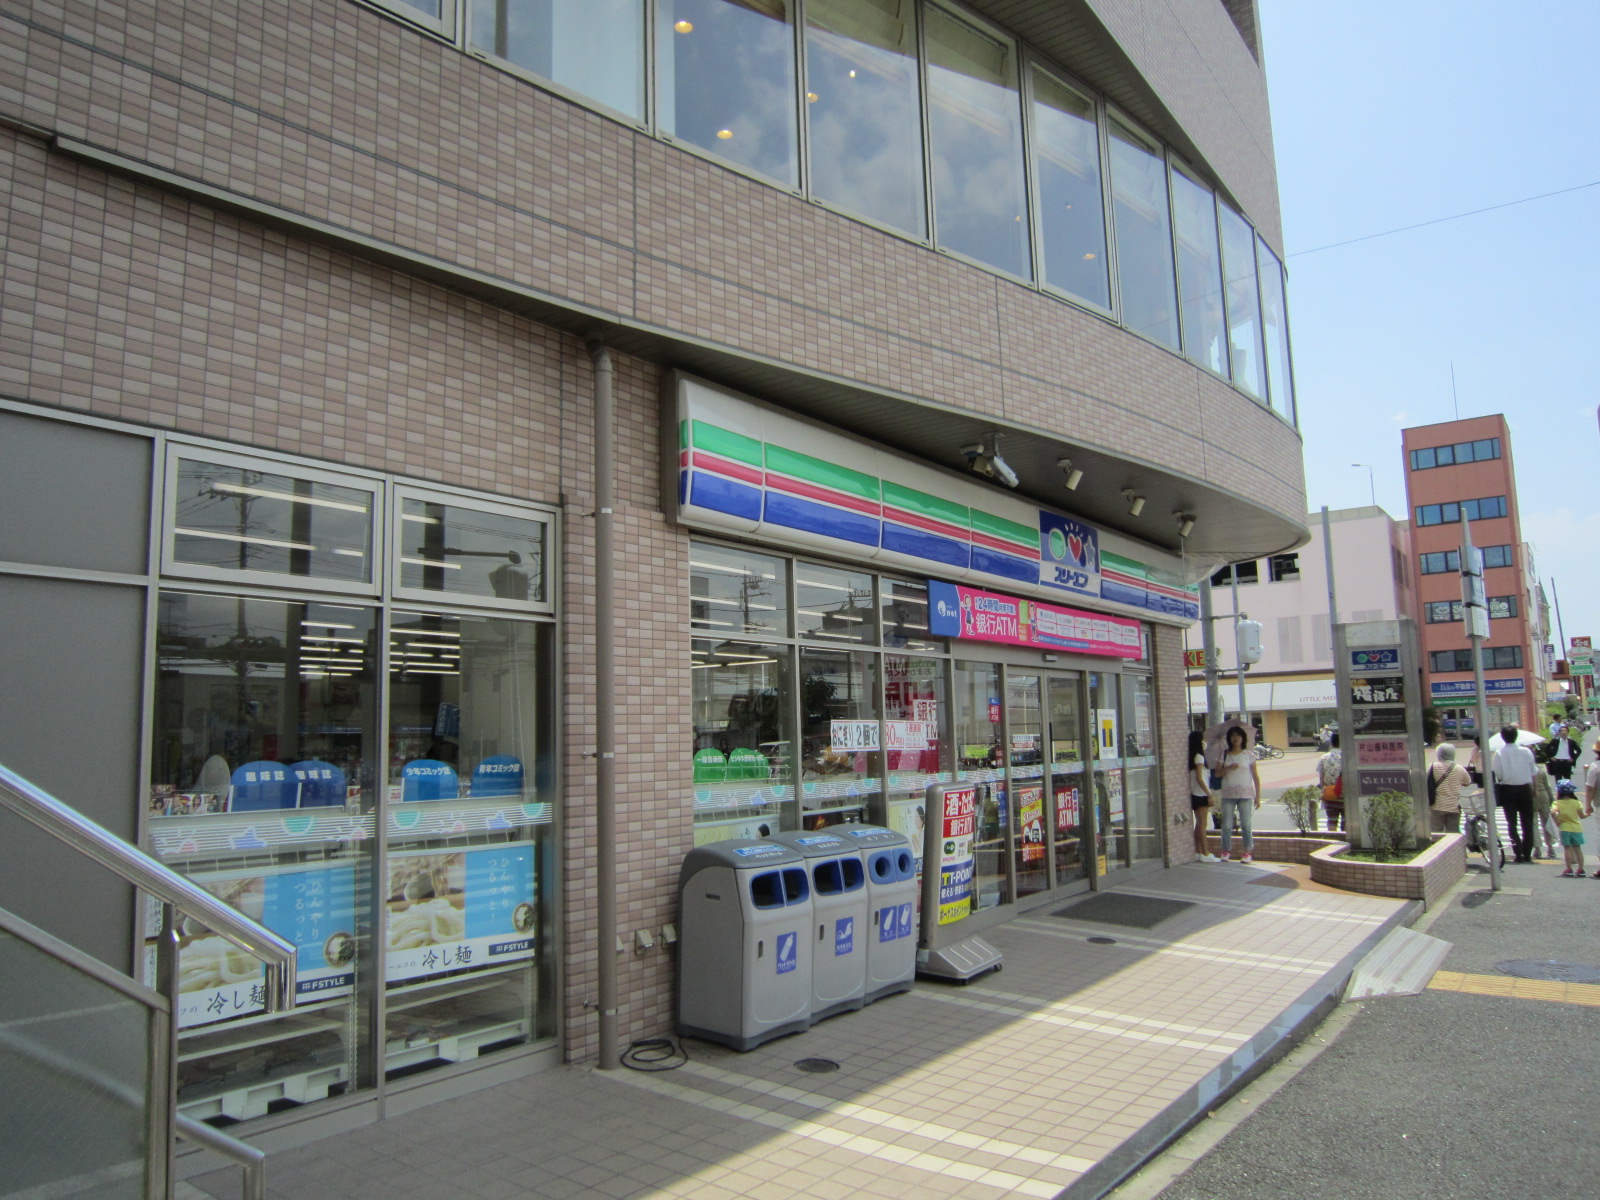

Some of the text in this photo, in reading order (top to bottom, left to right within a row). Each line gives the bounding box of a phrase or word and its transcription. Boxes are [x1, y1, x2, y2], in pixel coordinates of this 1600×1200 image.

[1053, 565, 1089, 588] スリーエフ
[975, 612, 1018, 638] 銀行ATM
[1184, 650, 1205, 667] KE
[406, 766, 451, 777] 少年コミック誌
[1057, 791, 1072, 810] 銀行
[1058, 809, 1073, 828] ATM
[501, 858, 511, 909] ひんやり
[310, 880, 322, 940] ひんやり
[388, 944, 473, 969] ーエフの 冷し麺
[503, 941, 529, 952] FSTYLE
[312, 976, 345, 990] FSTYLE
[206, 984, 265, 1015] 冷し麺
